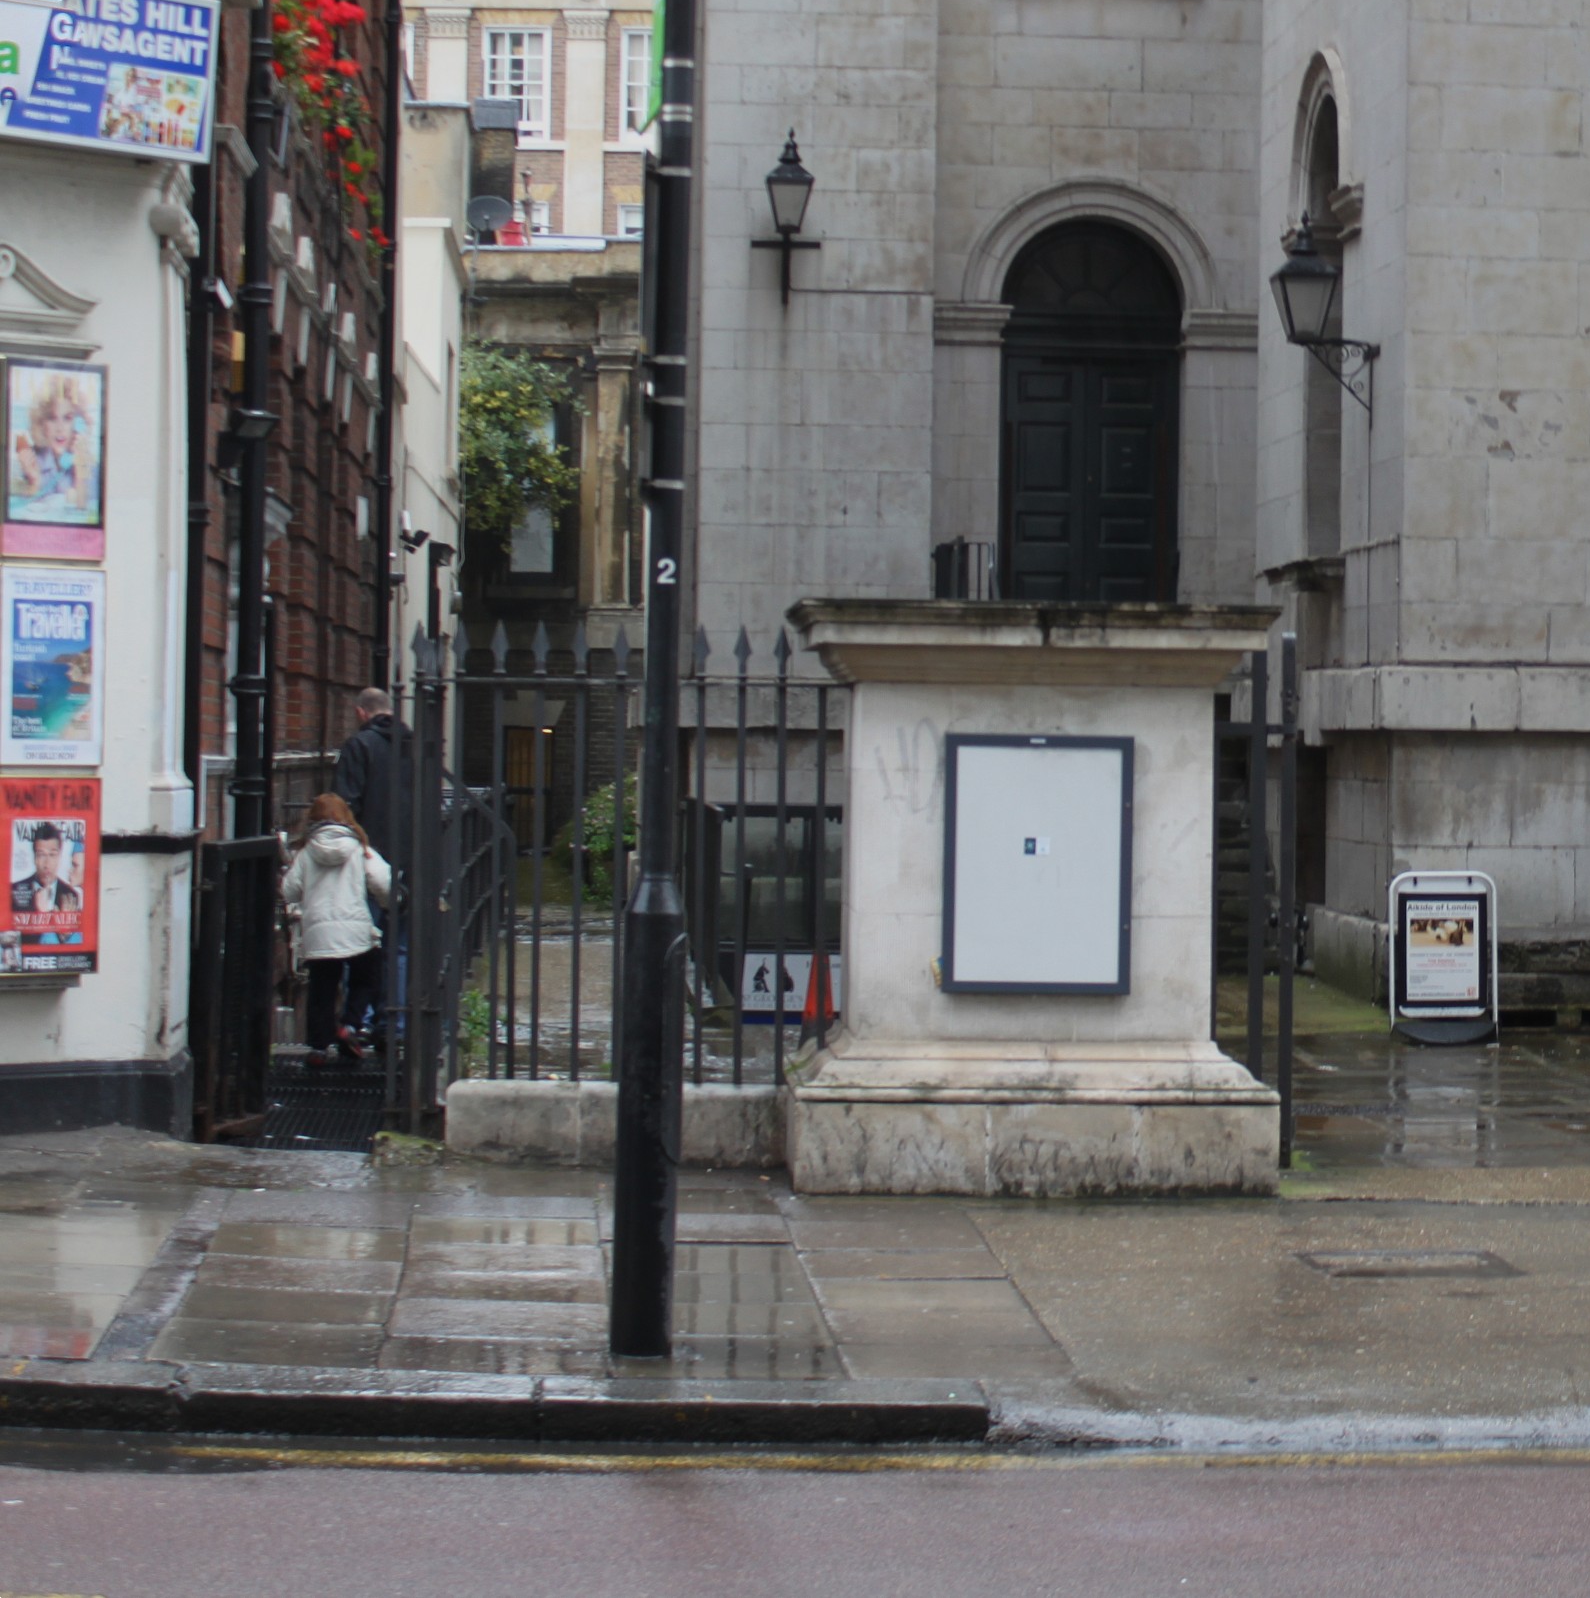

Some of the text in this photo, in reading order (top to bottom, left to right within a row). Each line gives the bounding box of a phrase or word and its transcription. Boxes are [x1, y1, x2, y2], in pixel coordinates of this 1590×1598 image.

[656, 557, 677, 585] 2
[4, 783, 94, 812] VANITY FAIR
[1447, 903, 1477, 911] London
[23, 956, 58, 970] FREE
